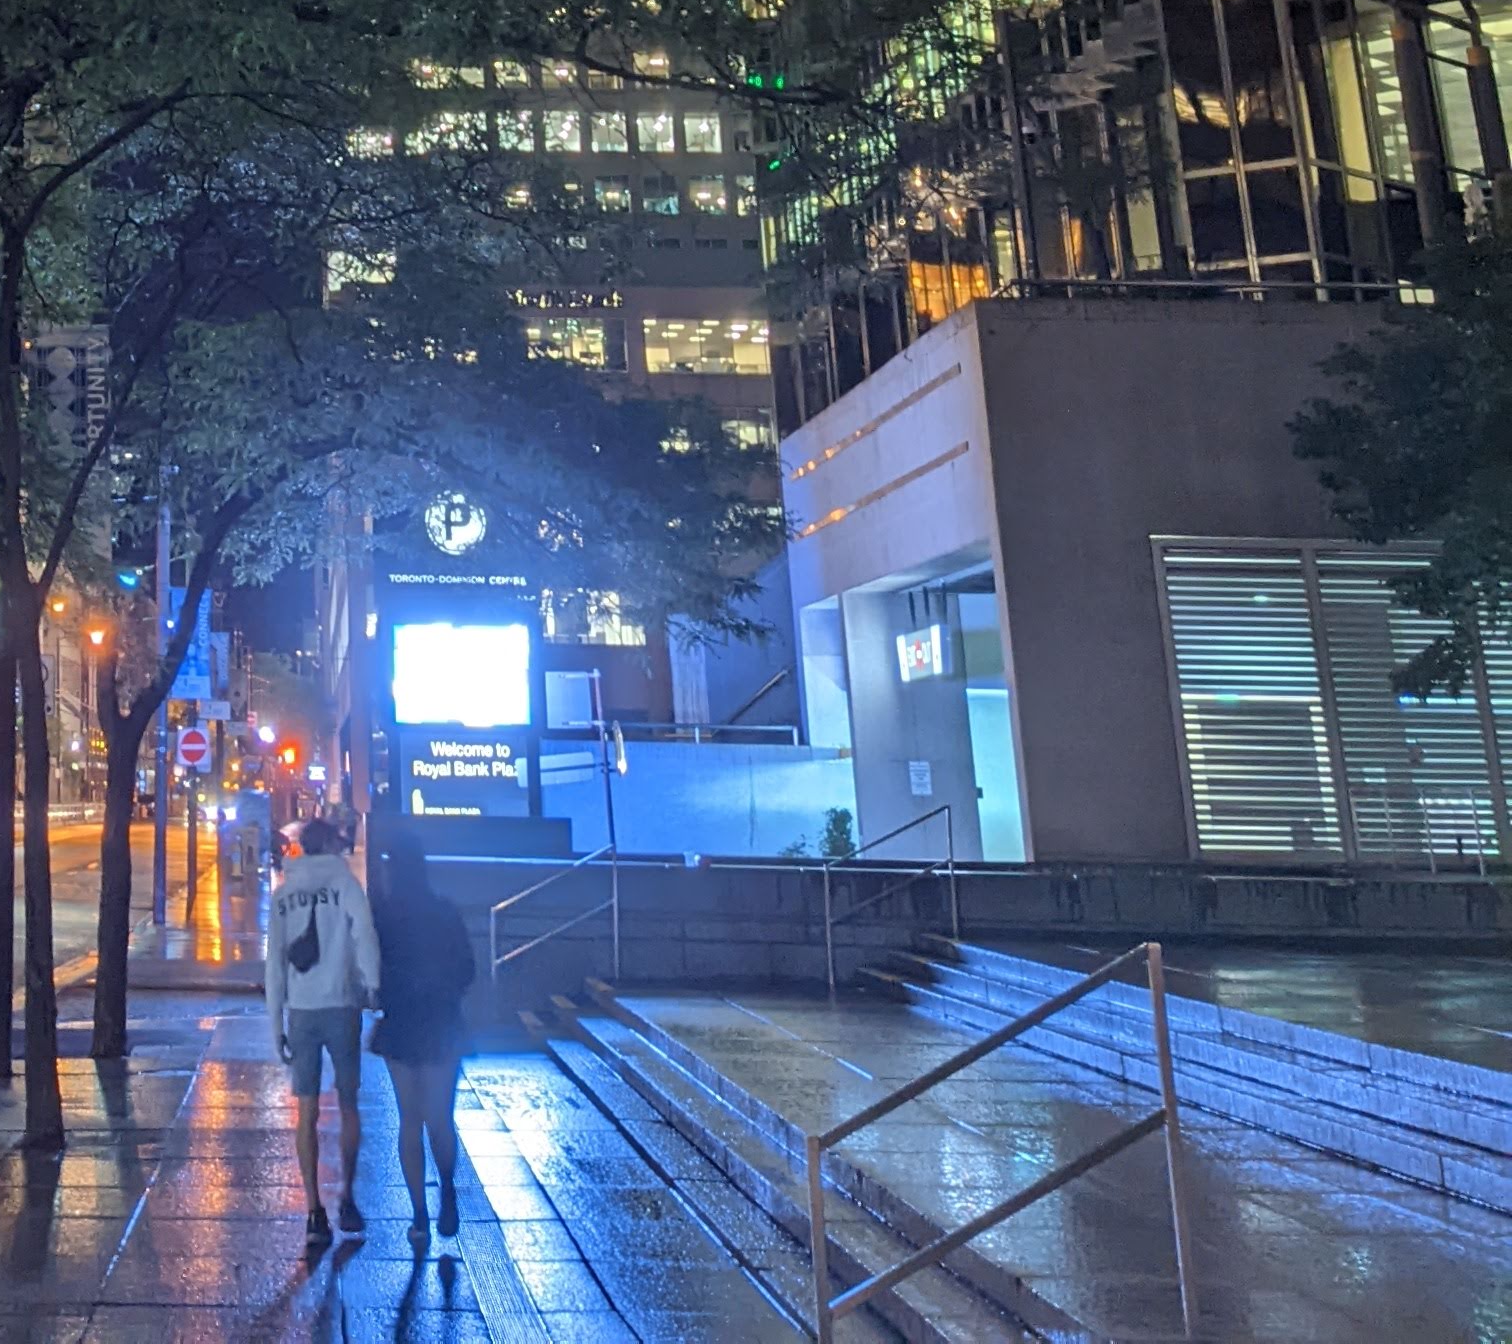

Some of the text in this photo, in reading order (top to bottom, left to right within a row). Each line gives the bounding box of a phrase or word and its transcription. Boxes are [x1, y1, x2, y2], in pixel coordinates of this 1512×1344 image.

[488, 575, 528, 586] CENRE
[430, 740, 511, 758] Welcome to
[412, 759, 519, 780] Royal Bank Pla
[277, 886, 340, 917] STUSY
